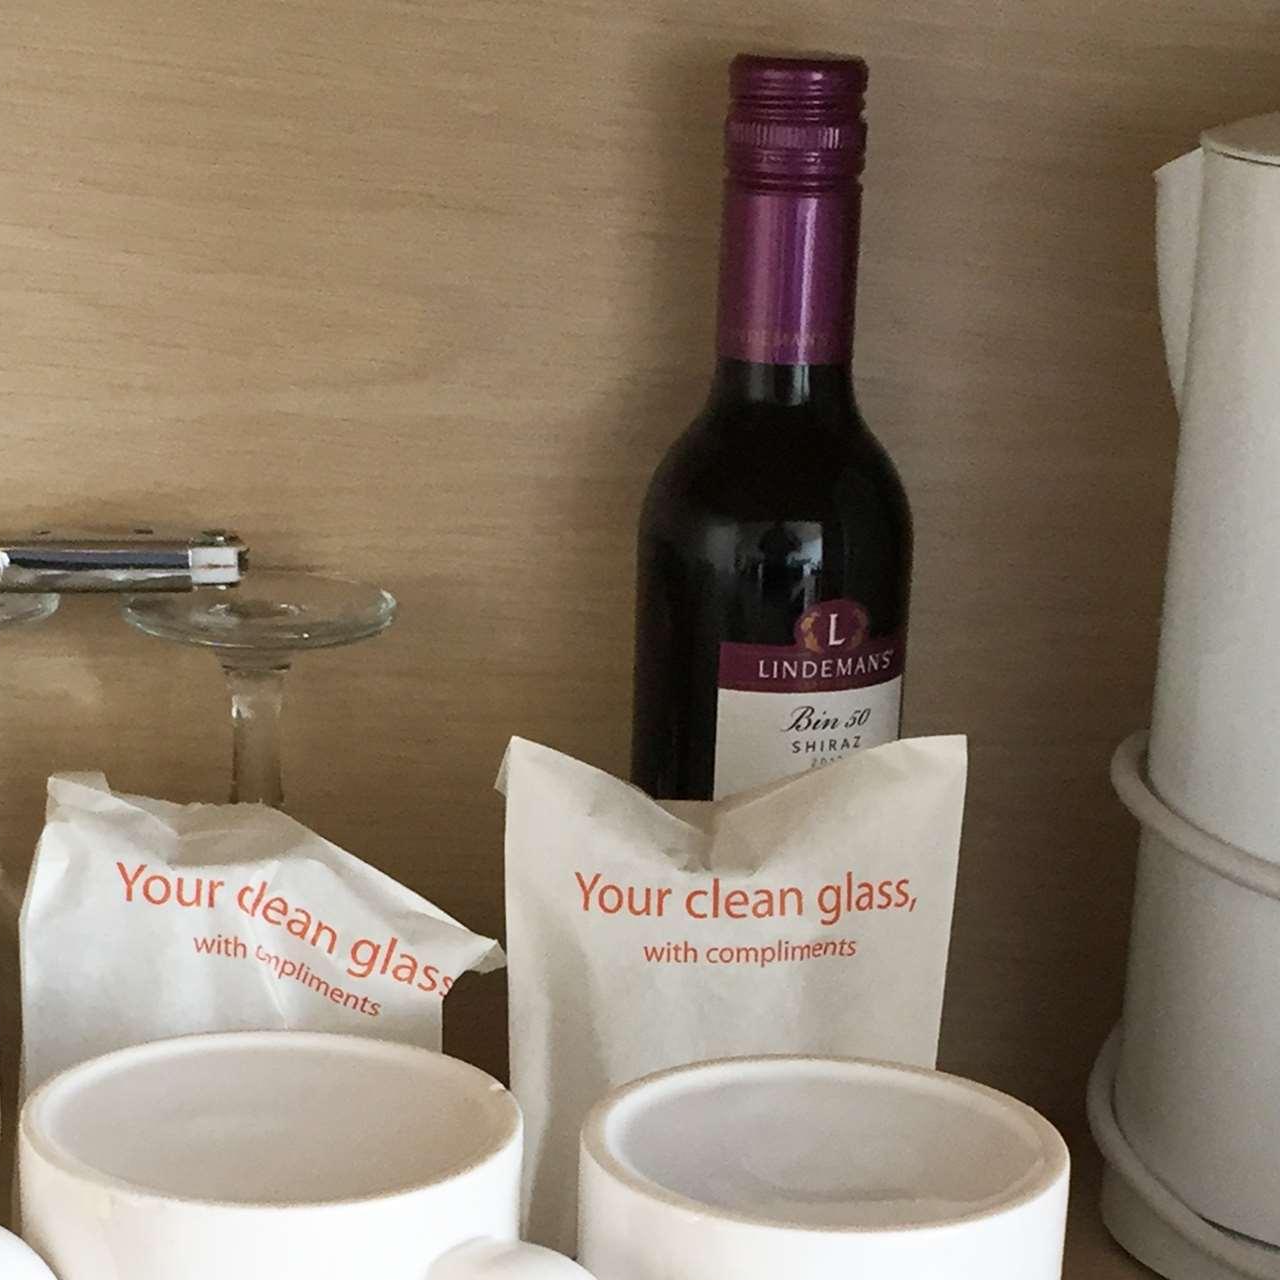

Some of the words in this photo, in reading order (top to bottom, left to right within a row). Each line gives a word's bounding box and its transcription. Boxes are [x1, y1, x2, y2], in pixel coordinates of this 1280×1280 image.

[828, 613, 846, 646] L
[758, 650, 892, 679] LINDEMANS
[780, 705, 840, 733] Bin
[844, 707, 872, 727] 50
[791, 735, 862, 754] SHIRAZ
[115, 860, 225, 909] Your
[235, 879, 339, 956] clean
[574, 871, 672, 918] Your
[684, 876, 804, 920] clean
[817, 870, 918, 926] glass,
[642, 940, 698, 965] with
[705, 937, 858, 968] compliments
[192, 933, 248, 960] with
[255, 943, 382, 1018] cmpliments
